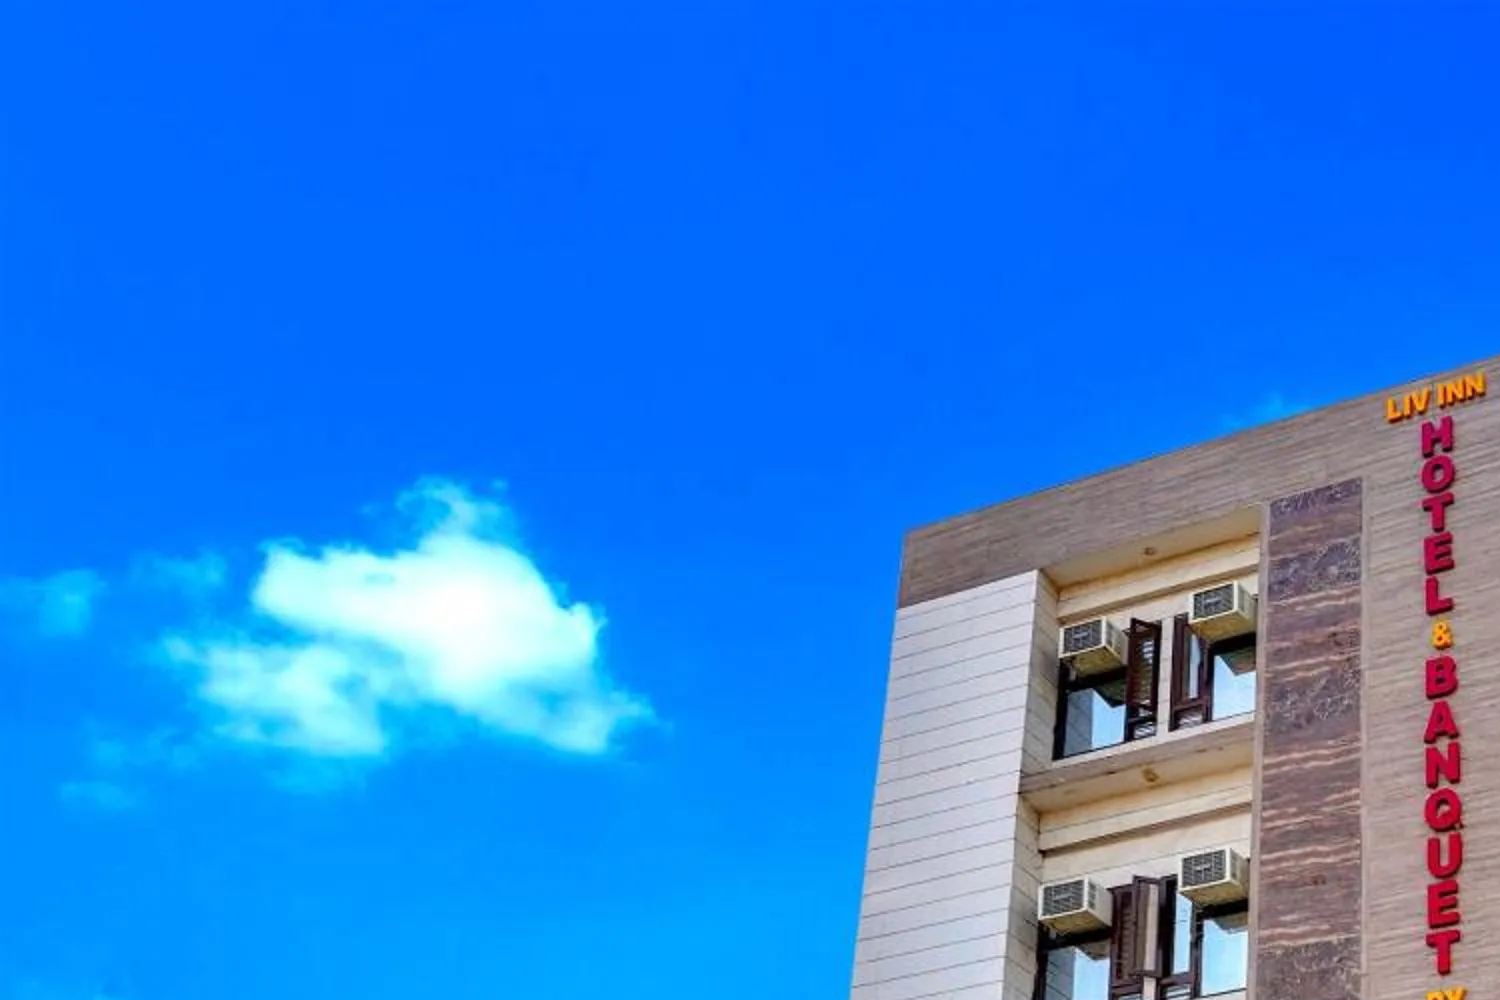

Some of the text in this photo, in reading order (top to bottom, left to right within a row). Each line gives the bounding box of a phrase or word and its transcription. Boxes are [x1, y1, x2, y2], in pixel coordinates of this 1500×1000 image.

[1386, 370, 1486, 424] LIV INN
[1420, 415, 1464, 976] HOTEL & BANQUET
